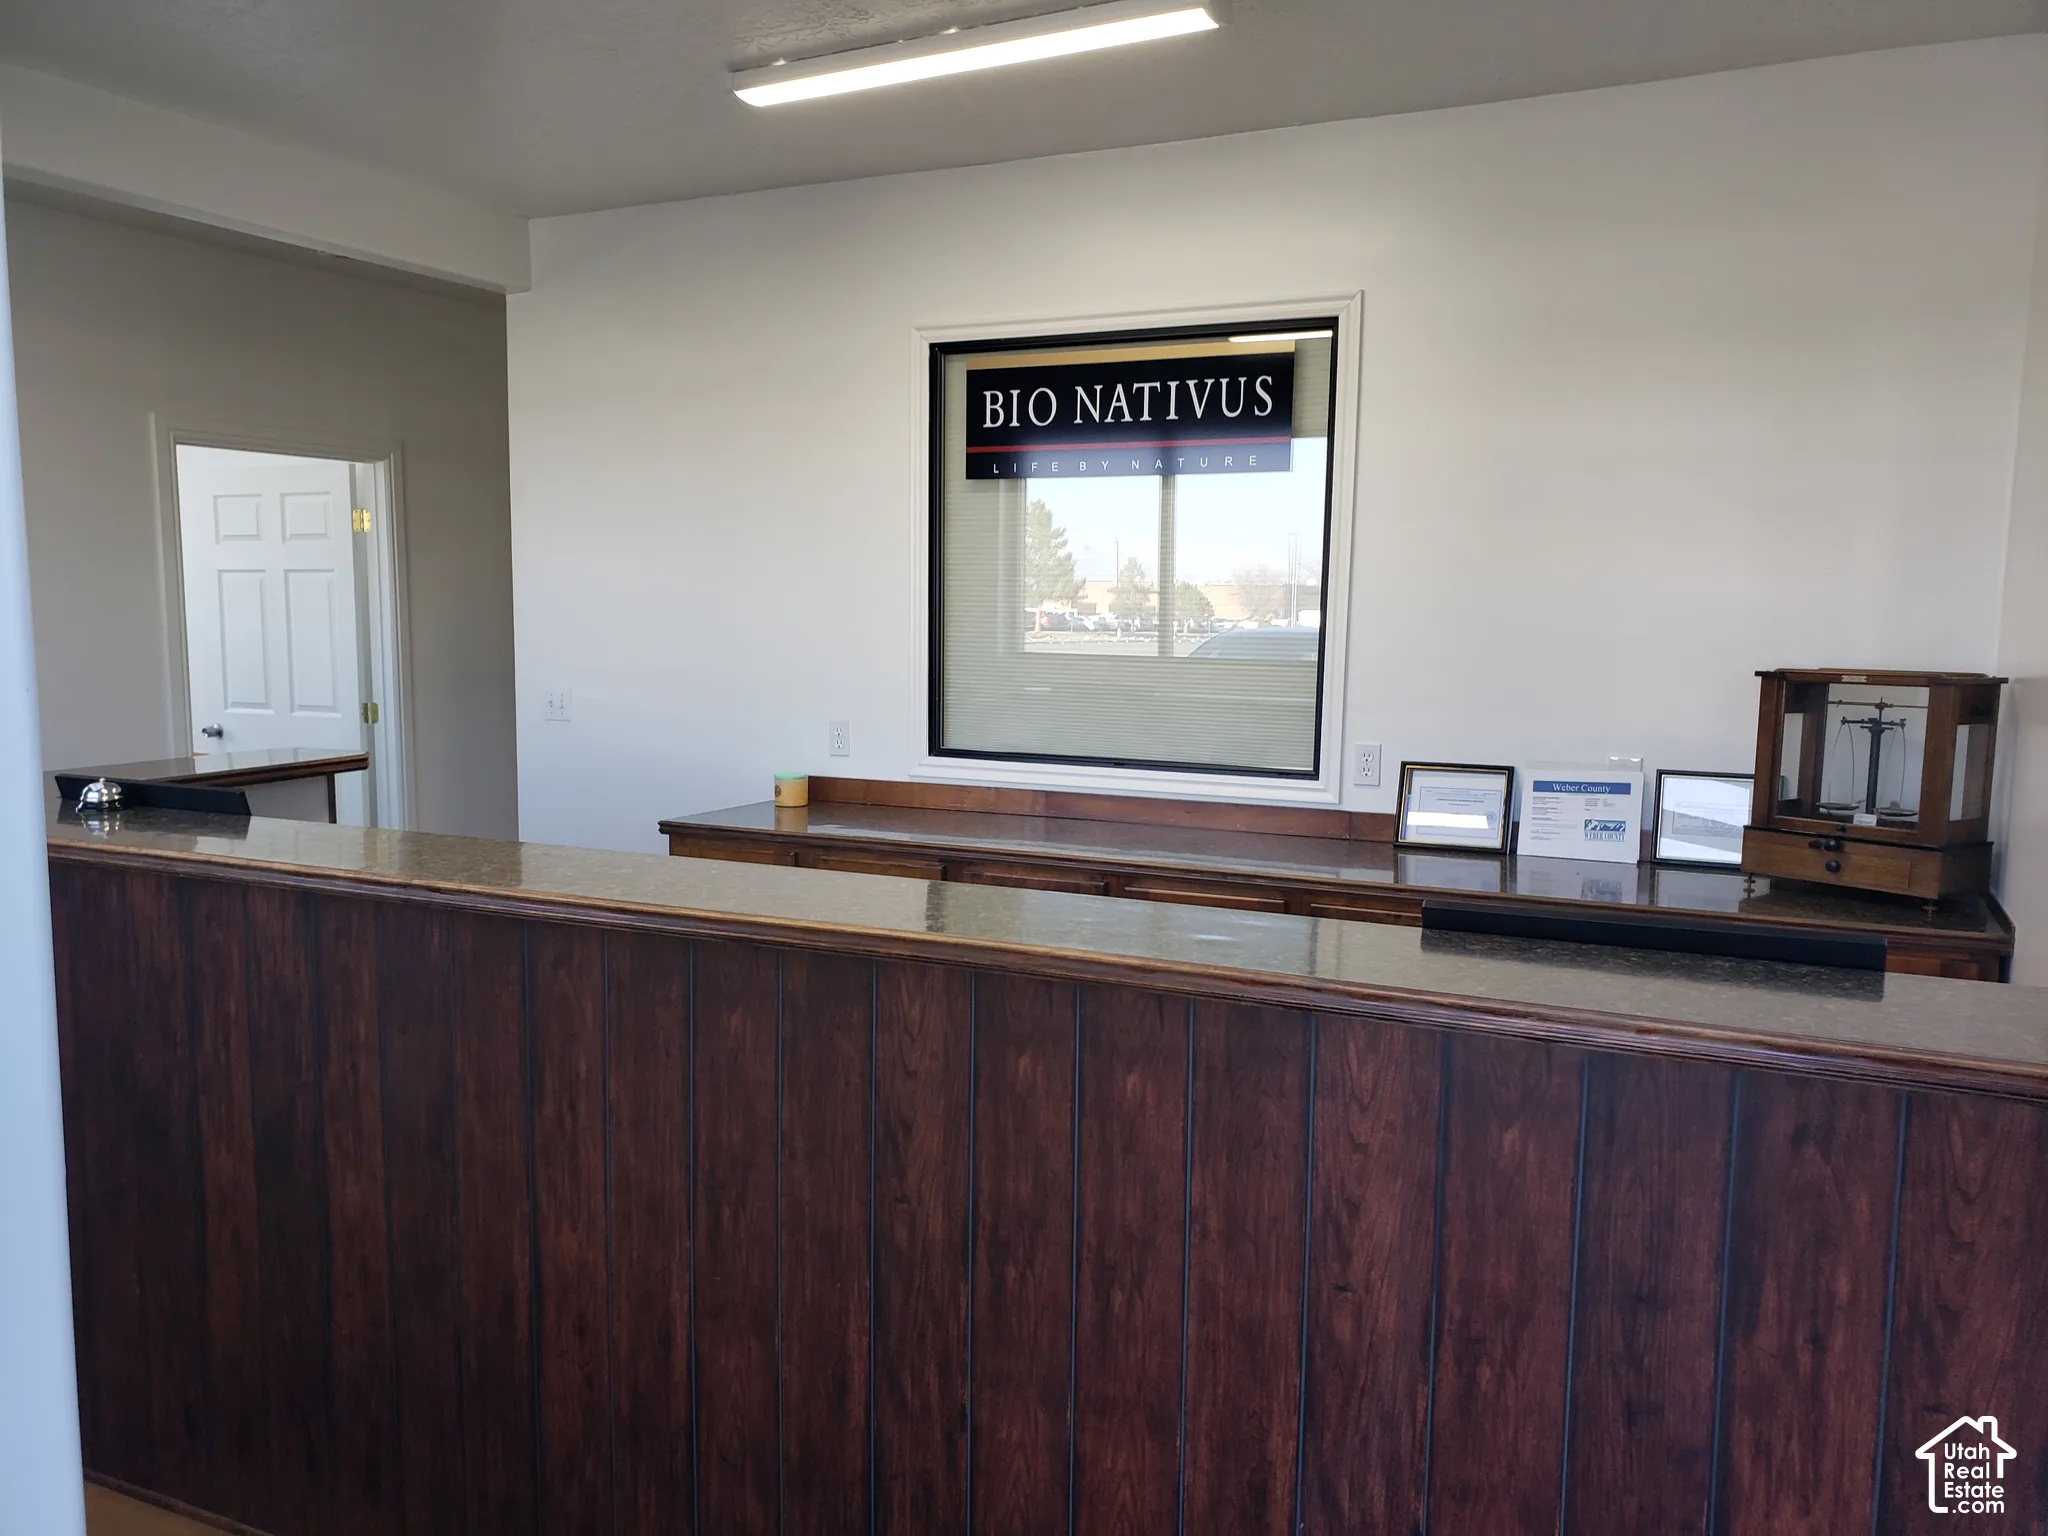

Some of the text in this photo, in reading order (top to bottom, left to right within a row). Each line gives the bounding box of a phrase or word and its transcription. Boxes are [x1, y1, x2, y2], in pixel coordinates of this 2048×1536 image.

[982, 375, 1273, 428] BIO NATIVUS
[992, 455, 1257, 474] LIFE BY NATURE
[1552, 782, 1611, 794] Weber County
